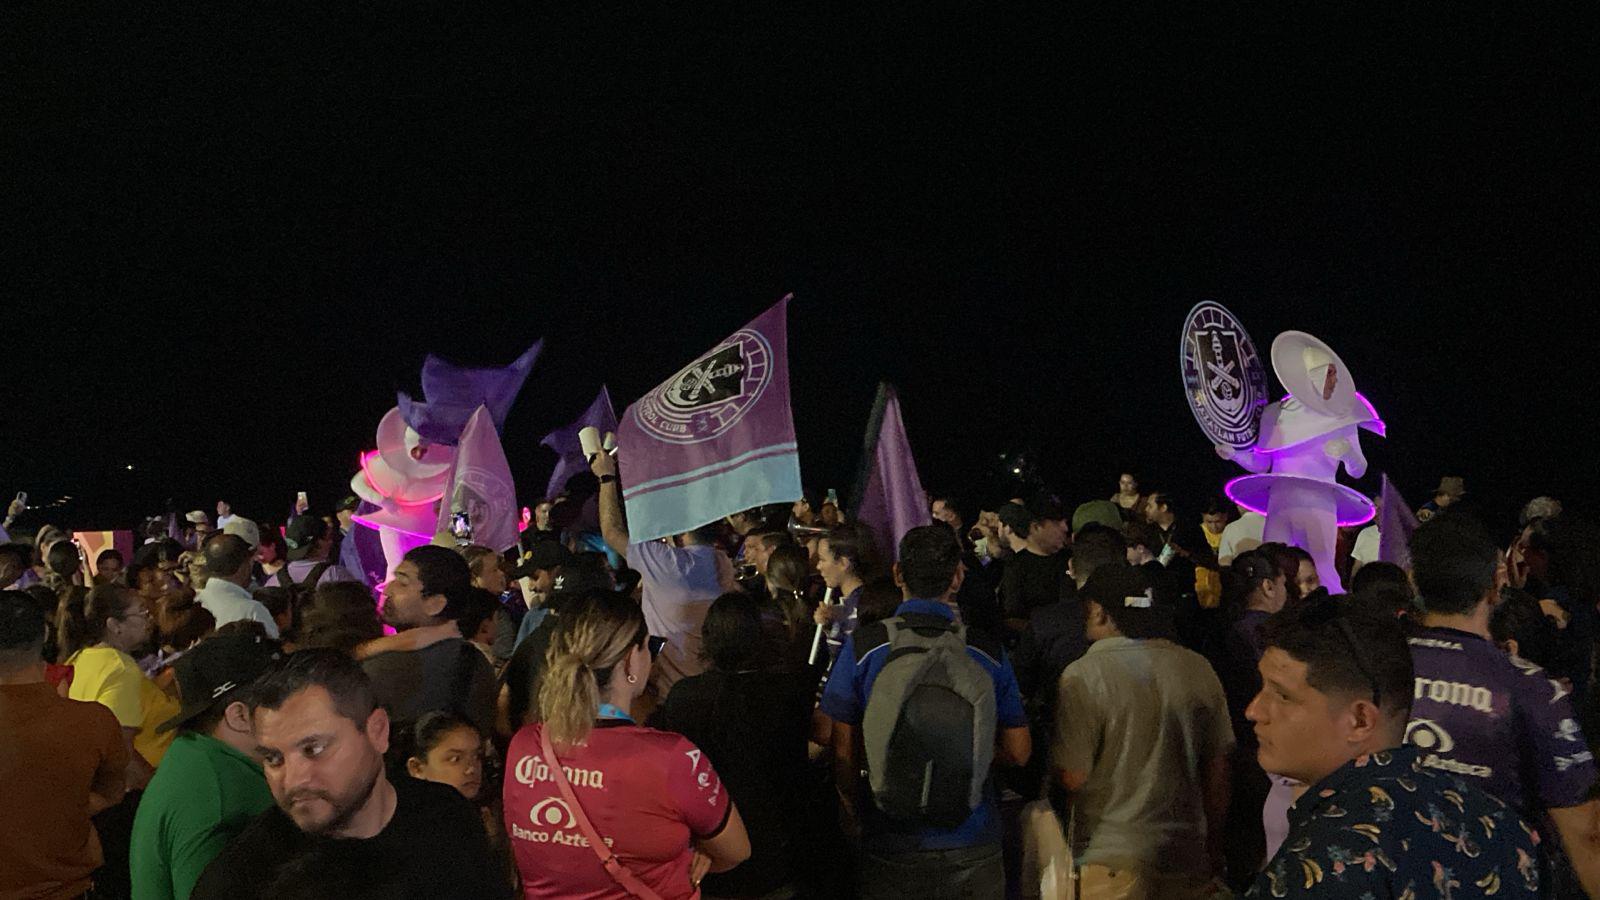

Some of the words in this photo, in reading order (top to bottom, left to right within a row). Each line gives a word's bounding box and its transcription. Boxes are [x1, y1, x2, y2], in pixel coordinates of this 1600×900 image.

[660, 421, 687, 433] CLUB
[1414, 676, 1493, 713] rona
[515, 755, 604, 788] Coona
[552, 830, 614, 848] Aztea
